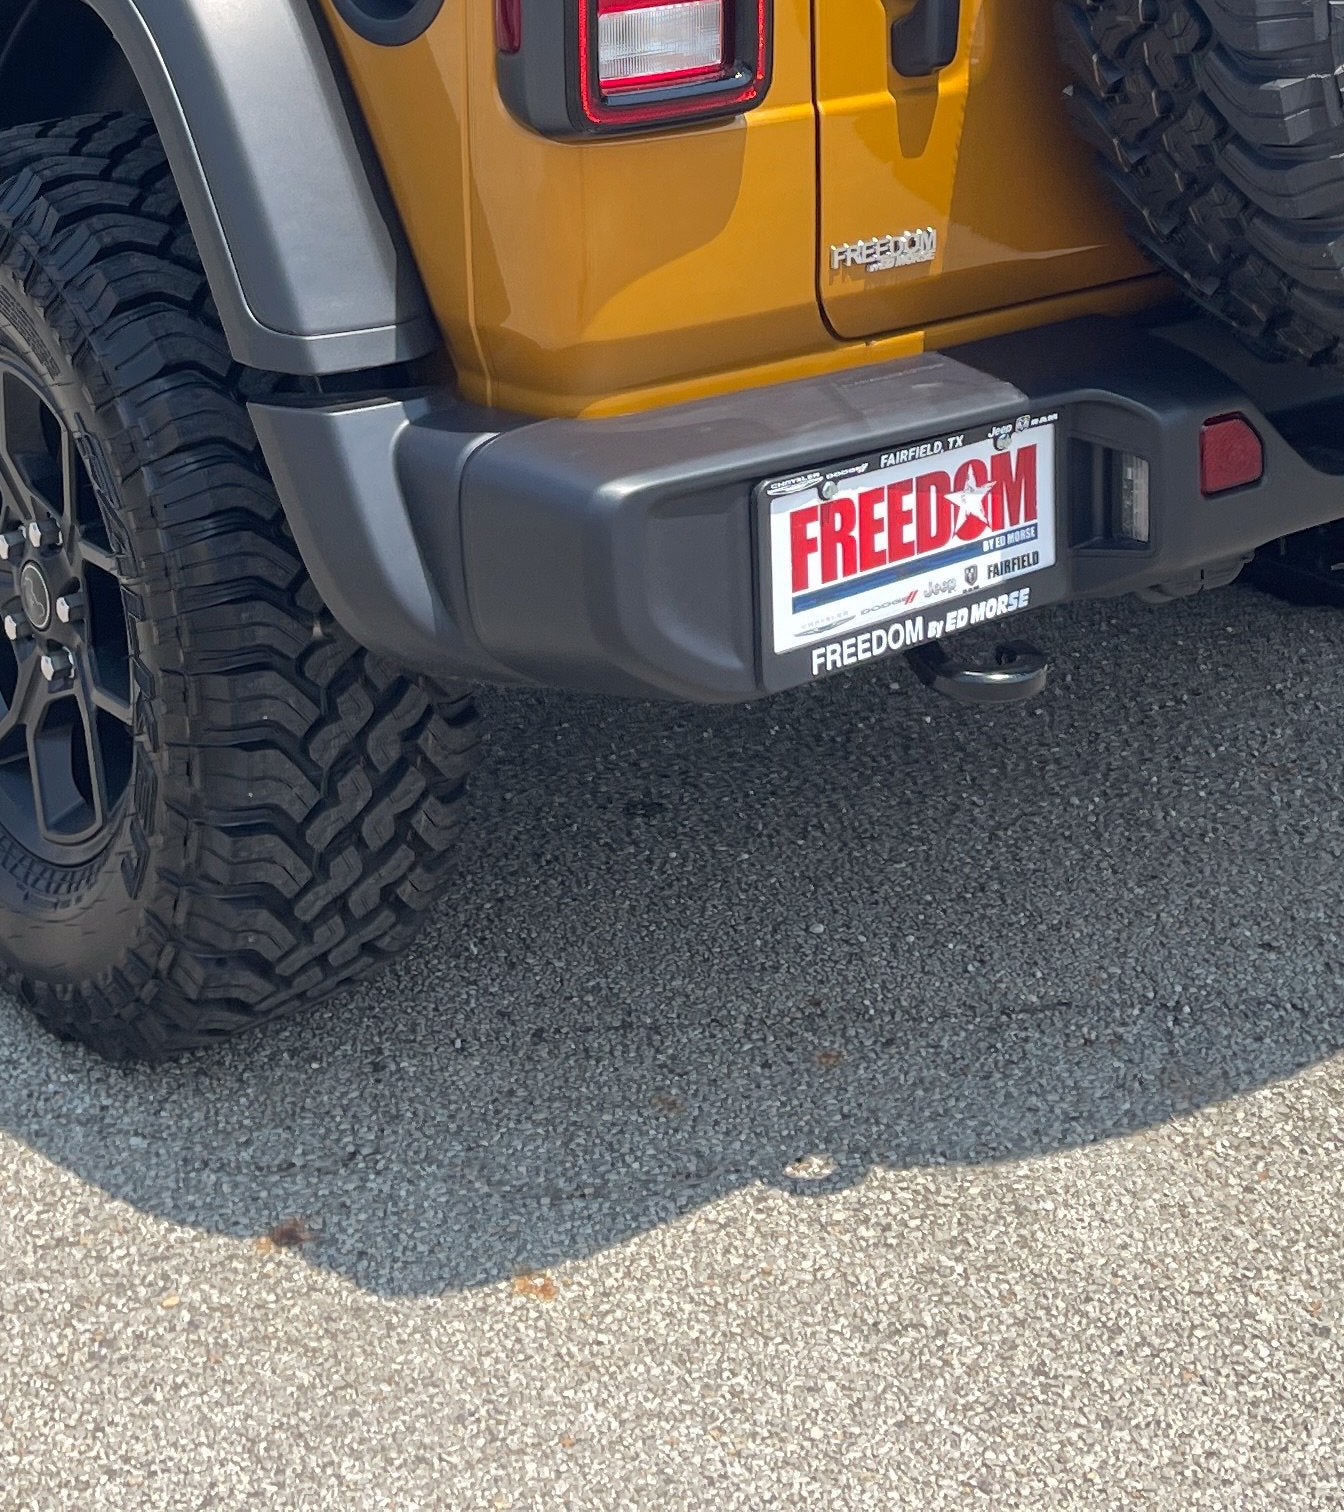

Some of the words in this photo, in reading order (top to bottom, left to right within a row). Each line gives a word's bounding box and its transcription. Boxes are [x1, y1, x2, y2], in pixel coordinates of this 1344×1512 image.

[830, 226, 937, 269] FREEDOM
[987, 424, 1013, 439] Jeep
[879, 441, 944, 469] FAIRFIELD,
[947, 434, 965, 450] TX
[770, 472, 821, 489] CHRYSLER
[789, 443, 1038, 594] FREEDOM
[982, 539, 995, 552] BY
[996, 536, 1006, 549] ED
[1007, 526, 1036, 545] MORSE
[987, 551, 1039, 580] FAIRFIELD
[923, 578, 957, 598] Jeep
[811, 615, 924, 675] FREEDOM
[945, 607, 969, 632] ED
[970, 586, 1031, 626] MORSE
